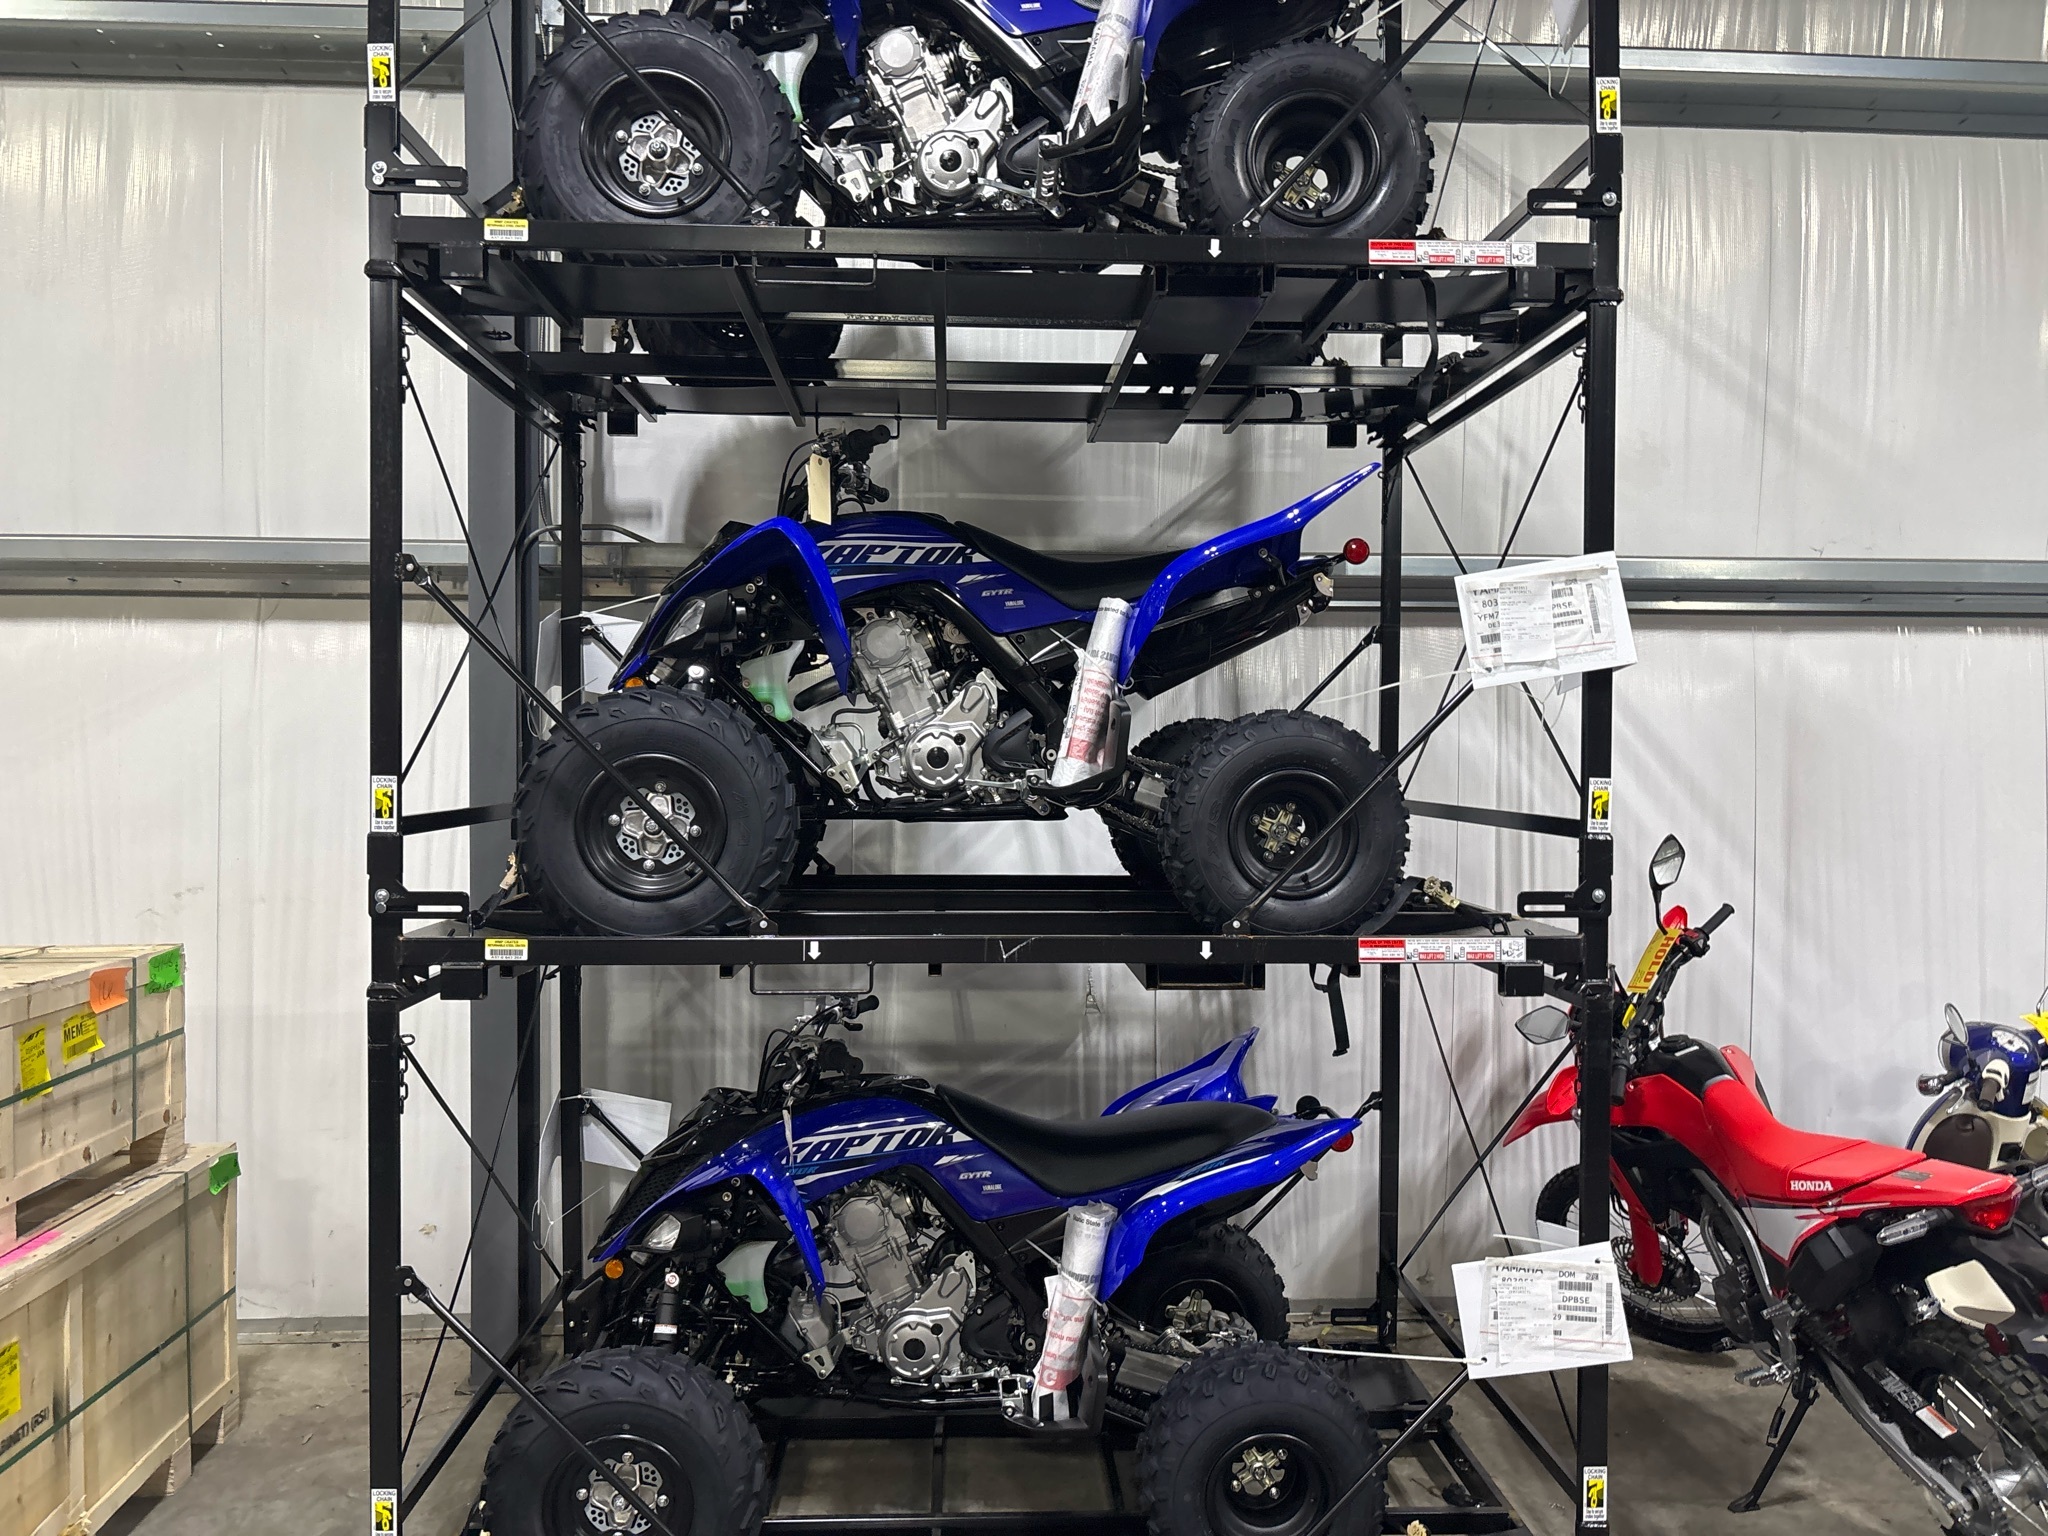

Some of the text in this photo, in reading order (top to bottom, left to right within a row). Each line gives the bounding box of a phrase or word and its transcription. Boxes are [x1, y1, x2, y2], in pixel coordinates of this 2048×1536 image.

[982, 588, 1014, 597] GYTR
[1482, 599, 1499, 608] 803
[1478, 612, 1500, 622] YFM7
[1644, 936, 1675, 983] HOLD
[64, 1022, 84, 1043] MEM
[959, 1171, 992, 1180] GYTR
[1790, 1180, 1833, 1191] HONDA
[1562, 1296, 1591, 1304] DPBSE
